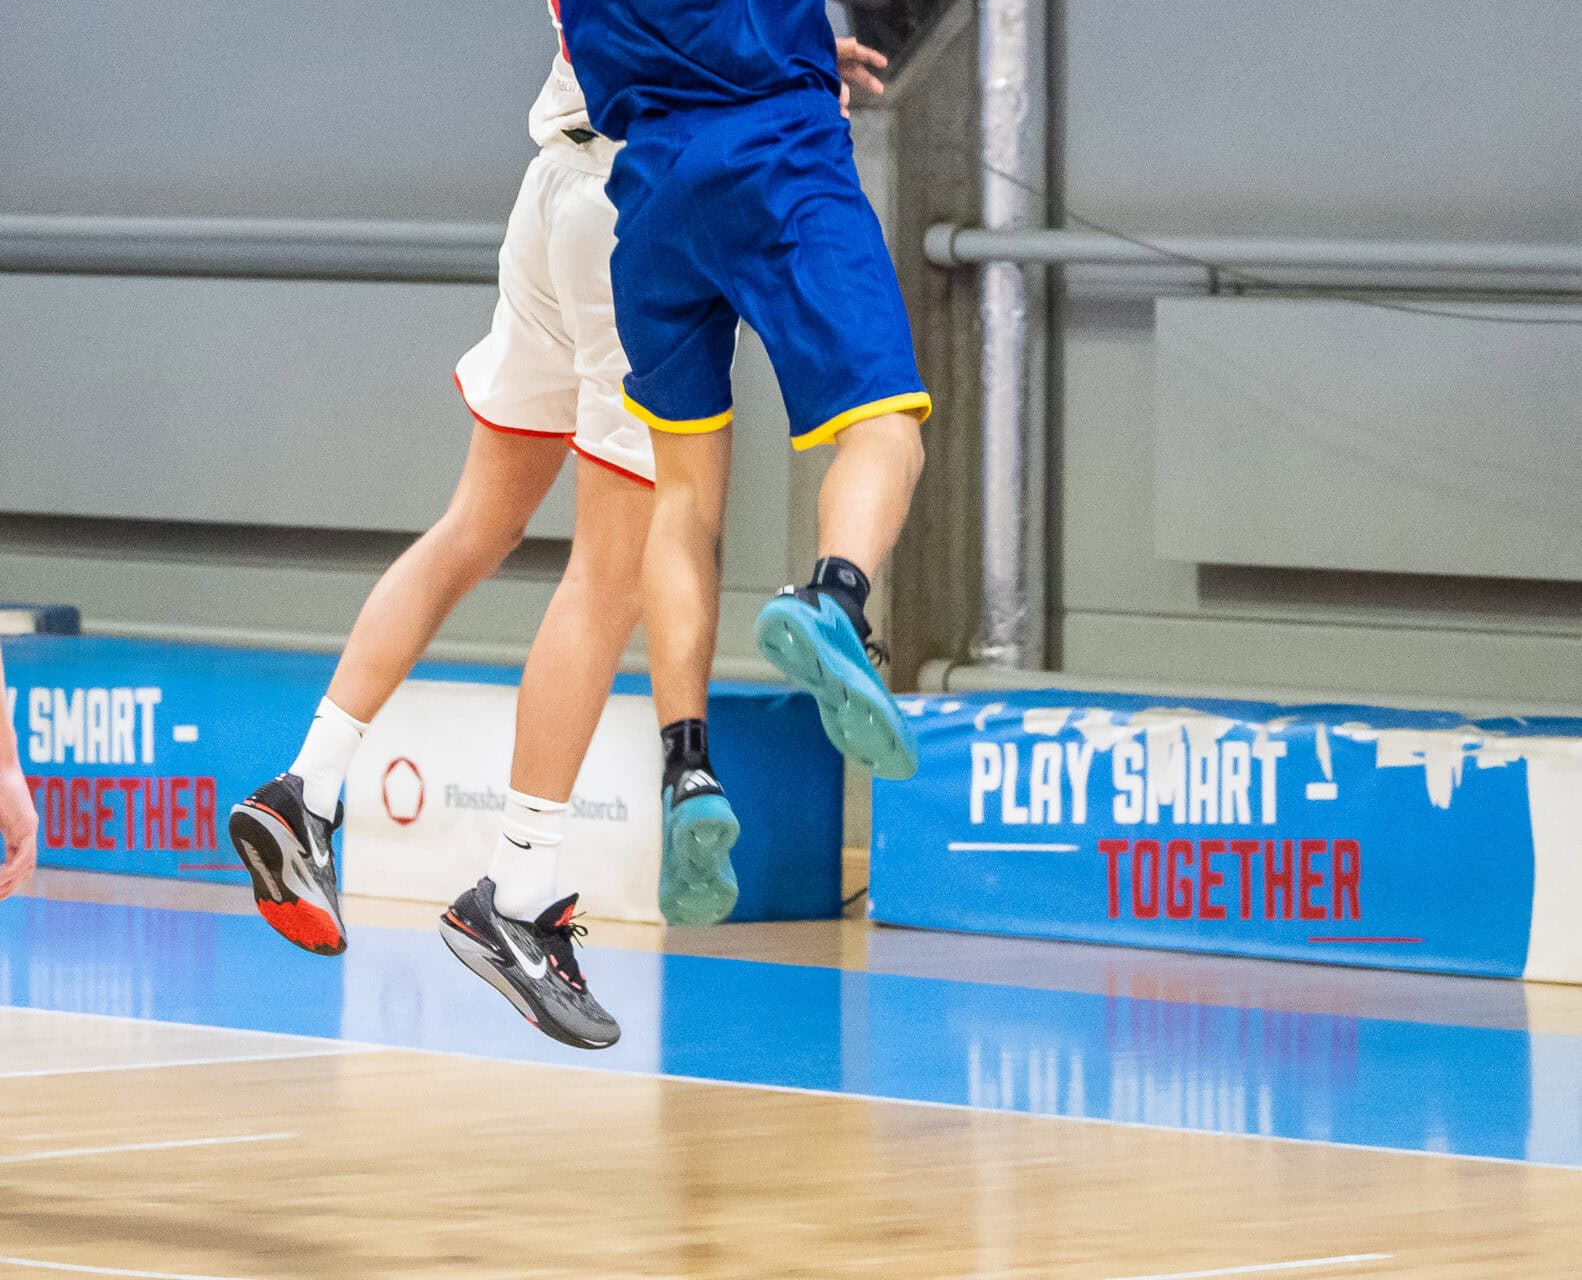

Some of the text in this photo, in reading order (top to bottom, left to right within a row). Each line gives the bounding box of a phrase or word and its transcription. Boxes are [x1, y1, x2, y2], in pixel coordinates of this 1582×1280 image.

[29, 687, 163, 764] SMART
[570, 794, 629, 822] Storch
[970, 741, 1094, 824] PLAY
[1112, 740, 1287, 824] SMART
[1098, 838, 1361, 920] TOGETHER
